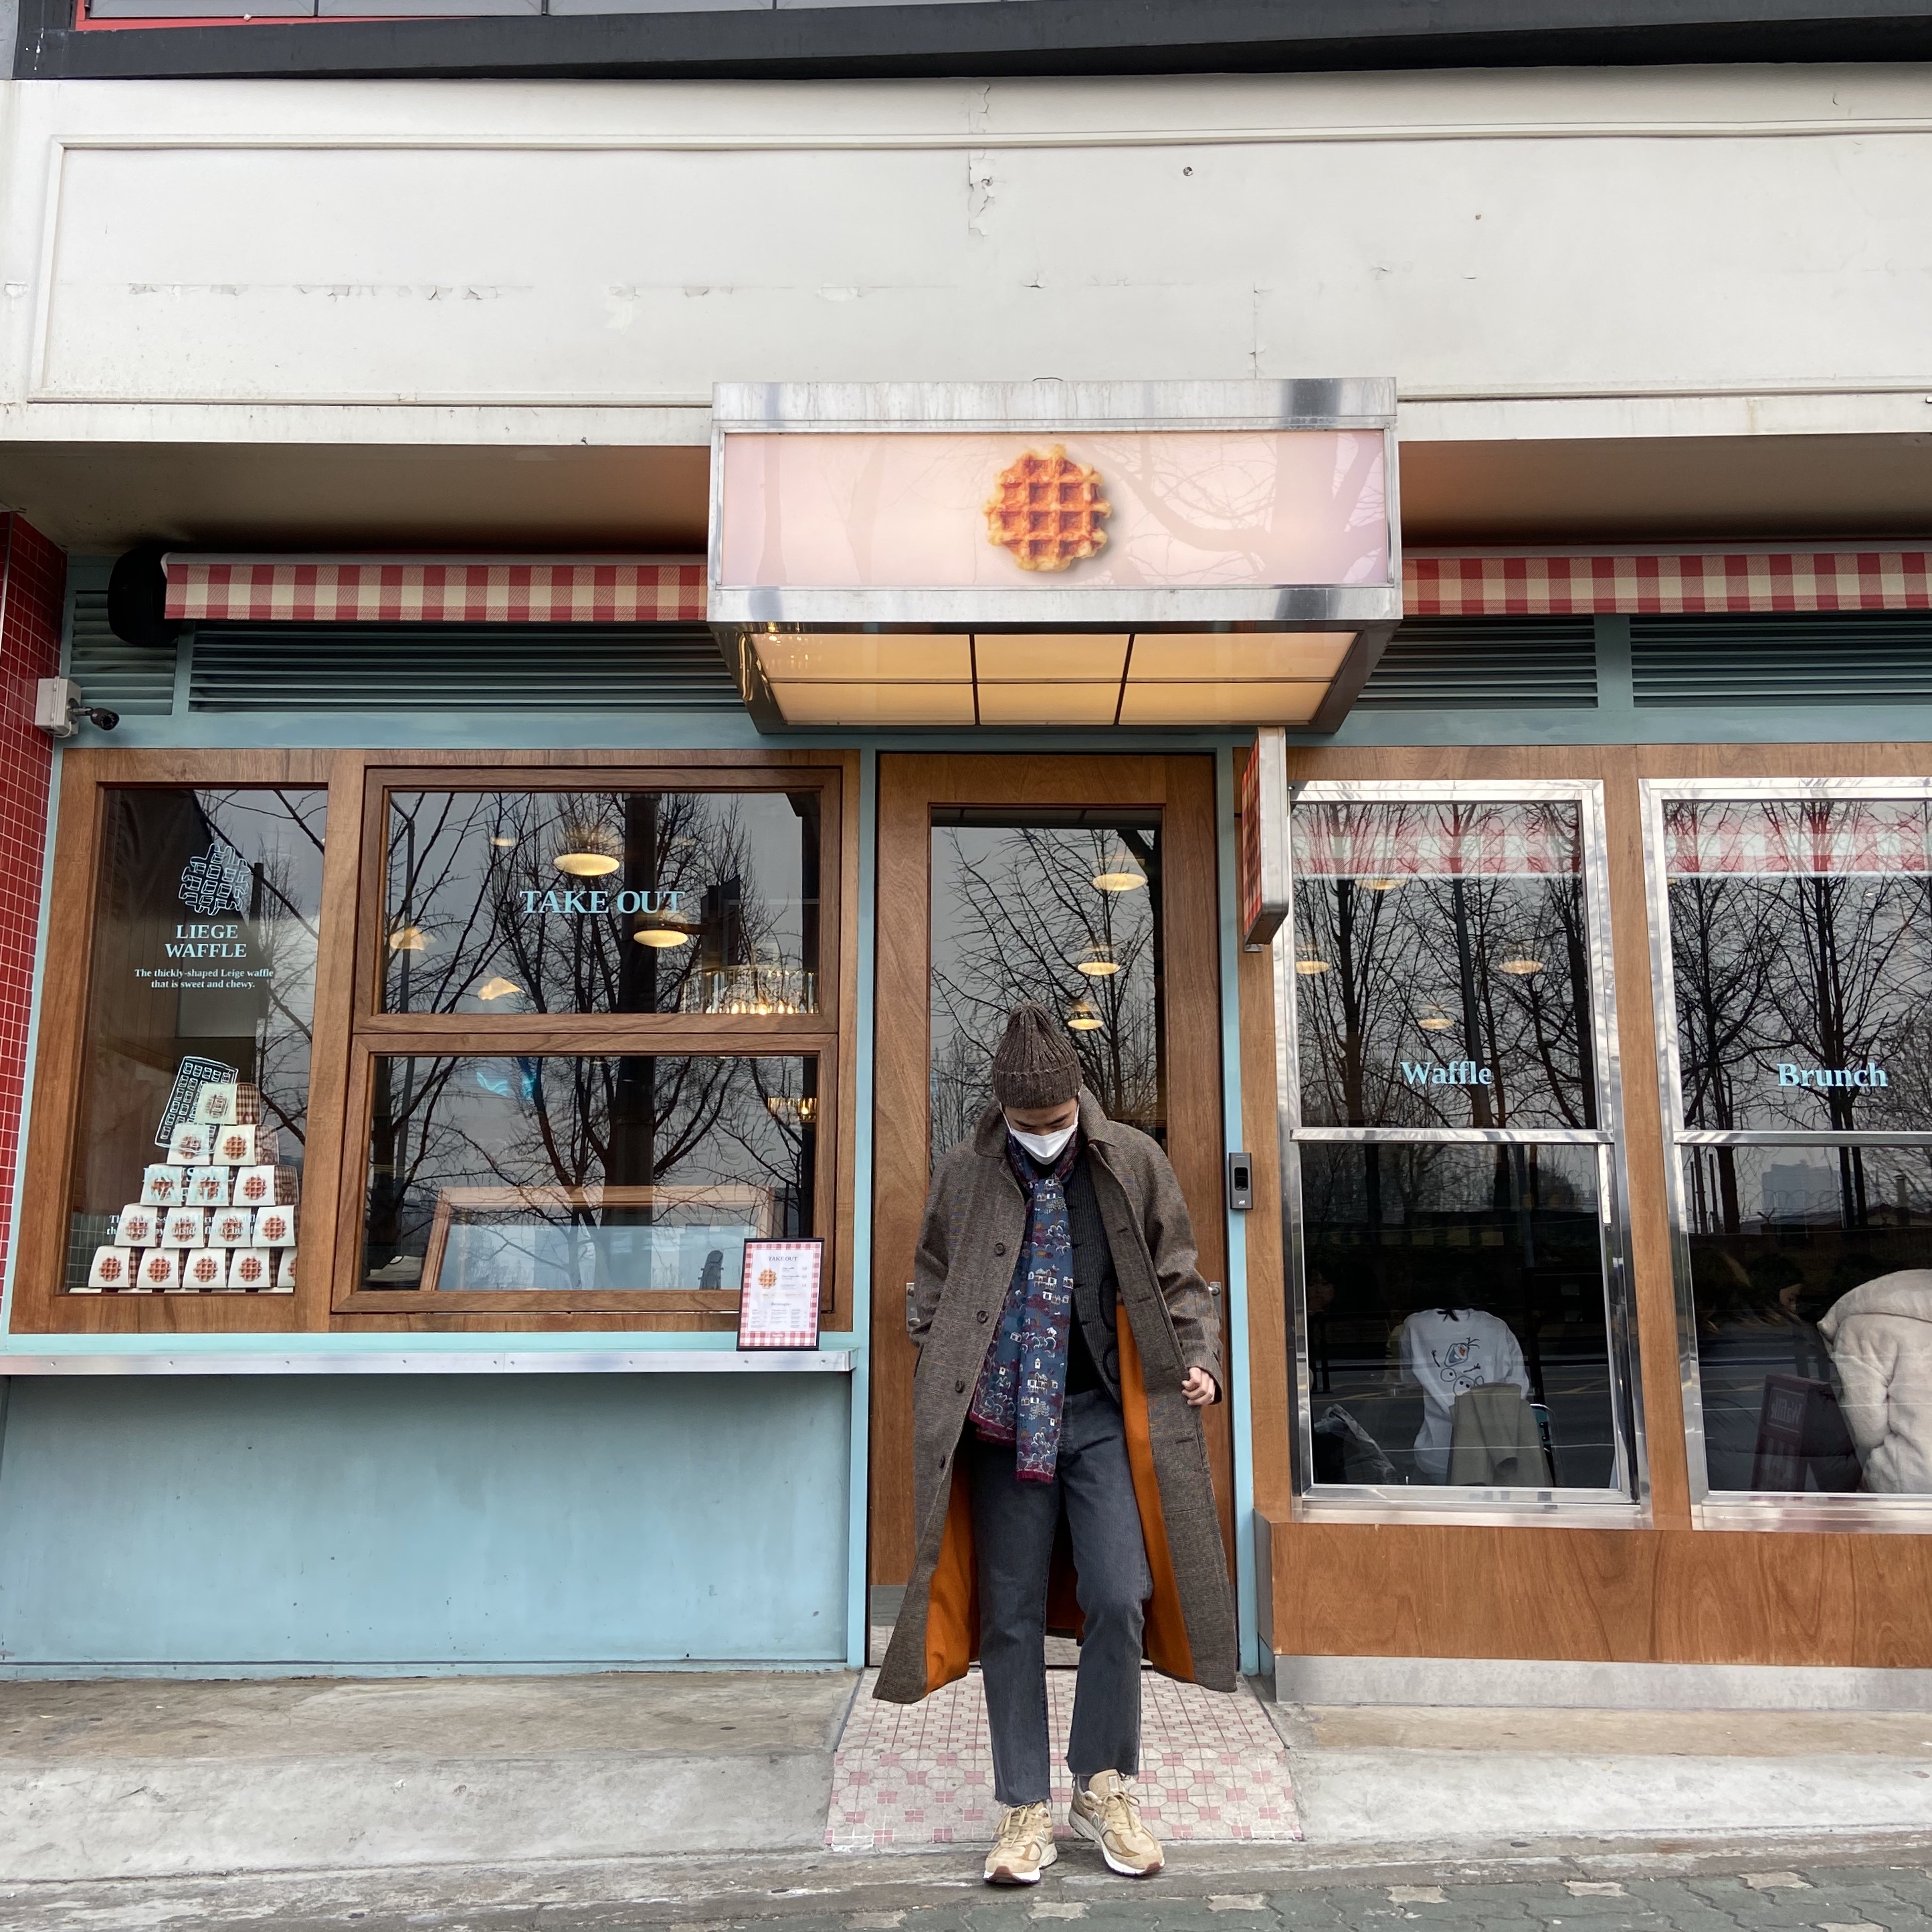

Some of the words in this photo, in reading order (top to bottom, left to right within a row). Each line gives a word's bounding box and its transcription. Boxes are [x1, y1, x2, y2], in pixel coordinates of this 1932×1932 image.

[519, 890, 609, 914] TAKE
[617, 890, 686, 914] OUT
[176, 925, 238, 939] LIEGE
[165, 943, 247, 958] WAFFLE
[134, 969, 152, 977] The
[154, 969, 218, 979] thickly-shaped
[221, 969, 245, 979] Leige
[247, 969, 274, 977] waffle
[151, 980, 169, 988] that
[171, 980, 179, 988] is
[181, 980, 205, 988] sweet
[207, 980, 224, 988] and
[226, 980, 256, 989] chewy.
[1400, 1061, 1492, 1084] Waffle
[1776, 1062, 1888, 1087] Brunch
[142, 1167, 235, 1182] BRUSSEL
[146, 1187, 227, 1202] WAFFLE
